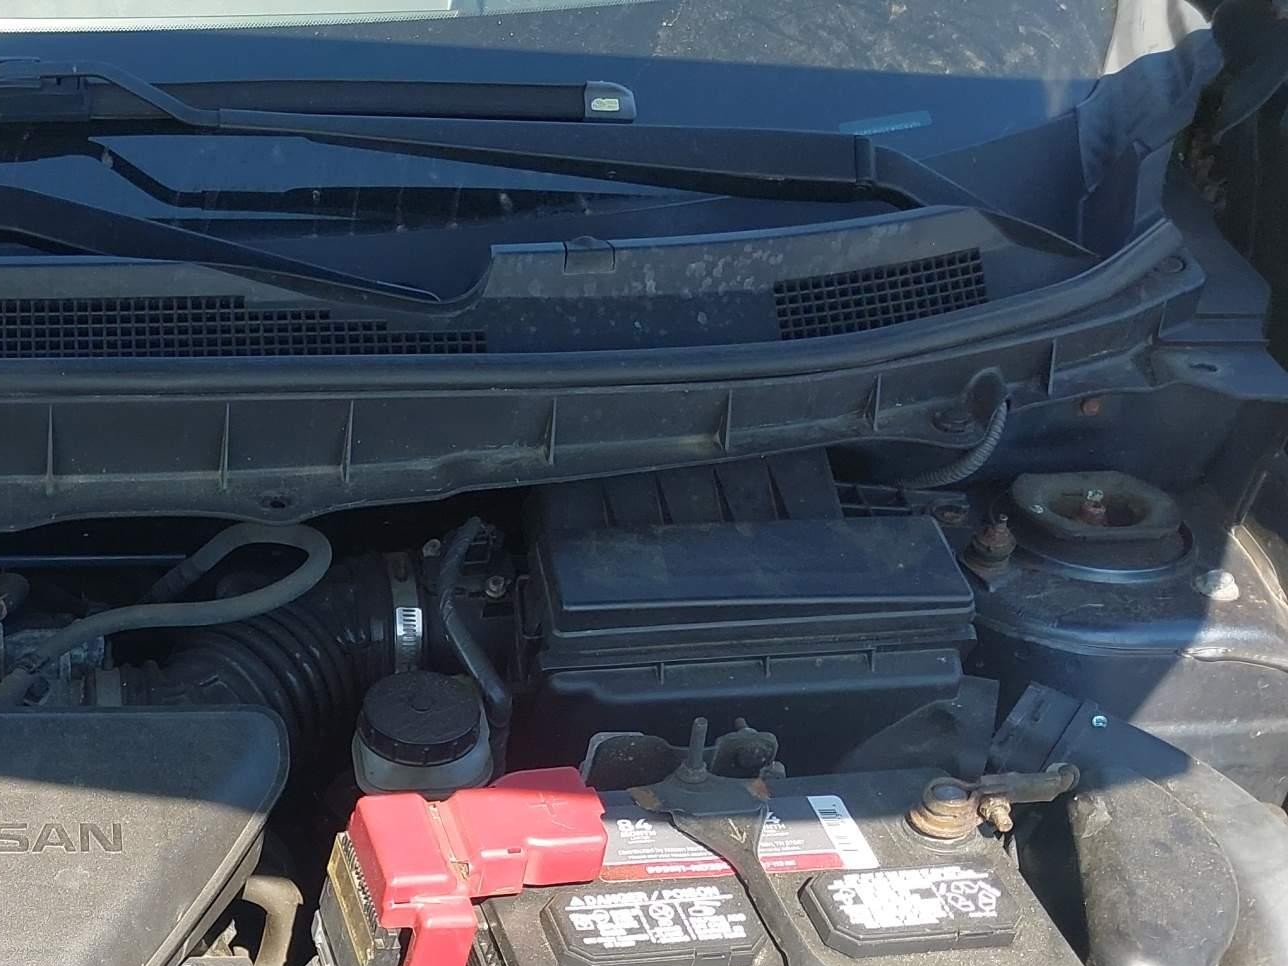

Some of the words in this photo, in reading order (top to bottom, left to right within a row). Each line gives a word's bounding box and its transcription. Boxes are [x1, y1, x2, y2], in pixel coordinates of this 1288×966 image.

[616, 819, 653, 832] 84
[584, 891, 649, 907] DANGER
[661, 886, 721, 900] POISON
